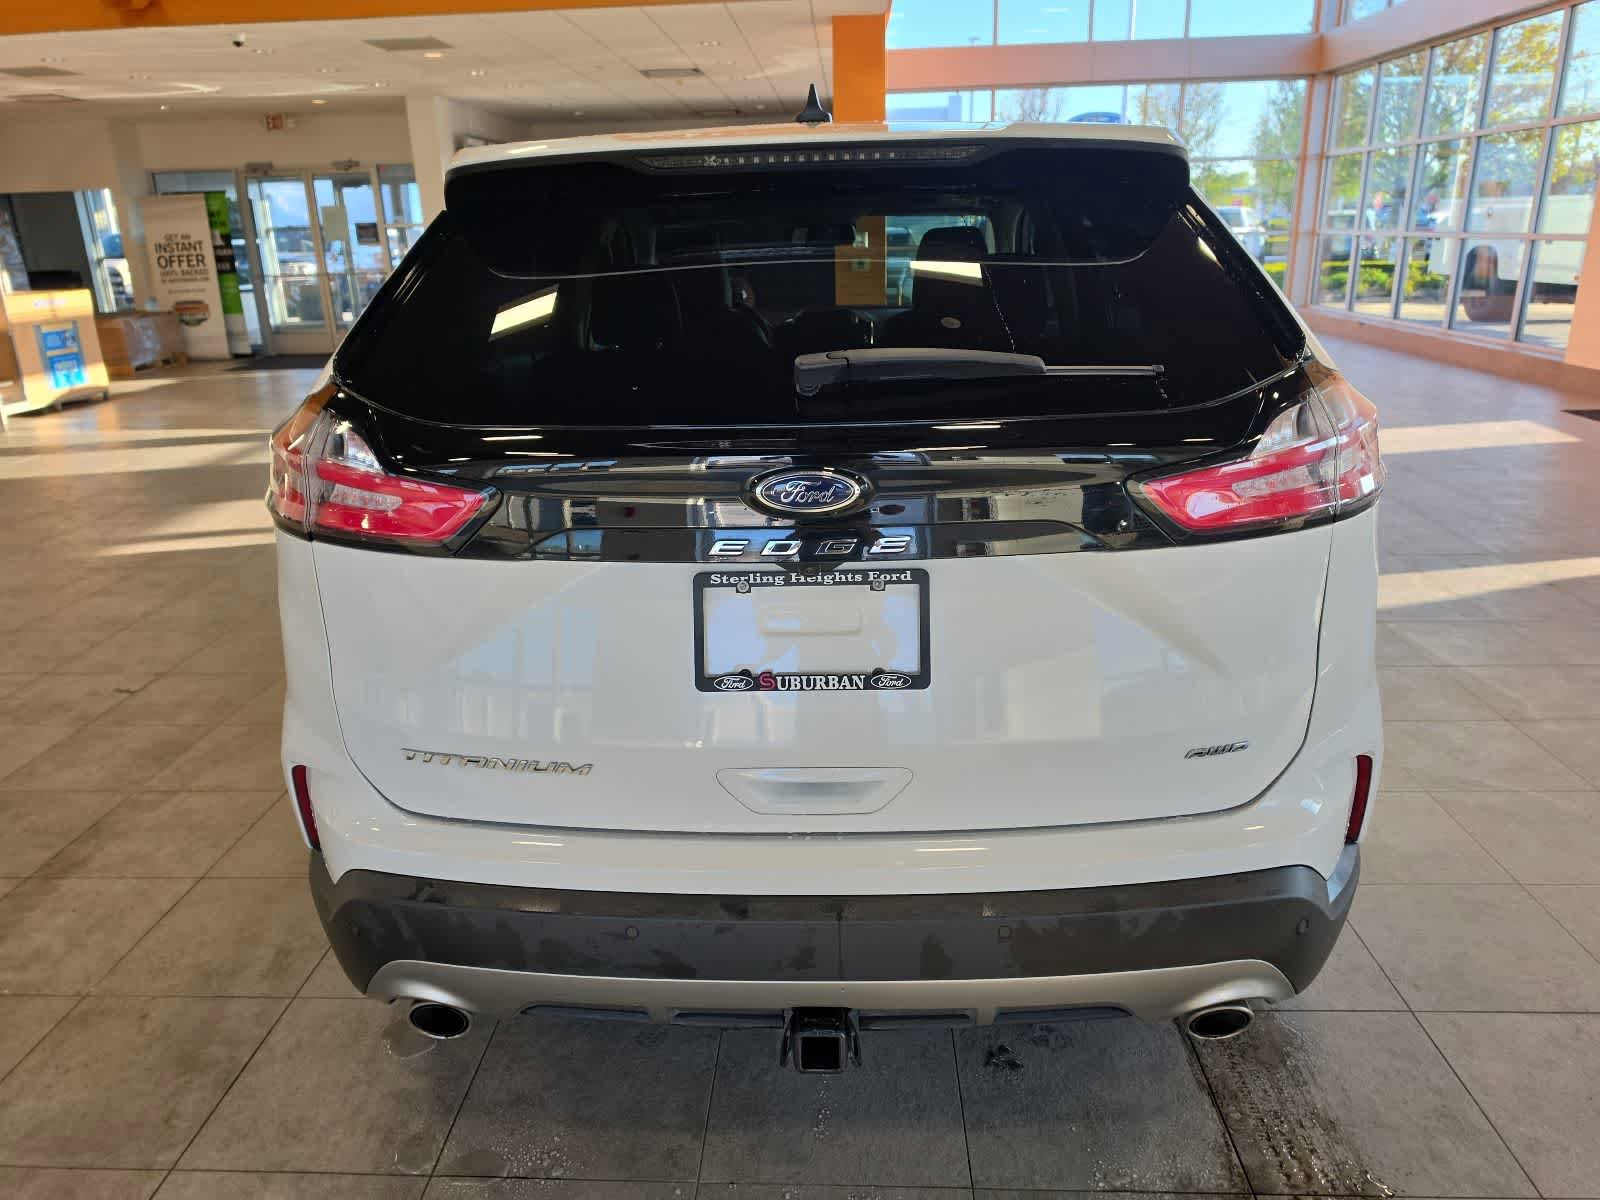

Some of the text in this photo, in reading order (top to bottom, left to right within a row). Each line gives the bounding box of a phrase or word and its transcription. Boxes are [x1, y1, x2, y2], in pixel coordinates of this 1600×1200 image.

[154, 240, 203, 254] INSTANT
[157, 253, 206, 270] OFFER
[780, 480, 836, 504] Ford
[708, 535, 912, 556] EDGE
[710, 570, 913, 586] Sterling Heights Ford
[758, 671, 866, 691] SUBURBAN
[877, 675, 904, 689] Ford
[1184, 740, 1249, 760] AWD
[400, 747, 594, 776] TITANIUM
